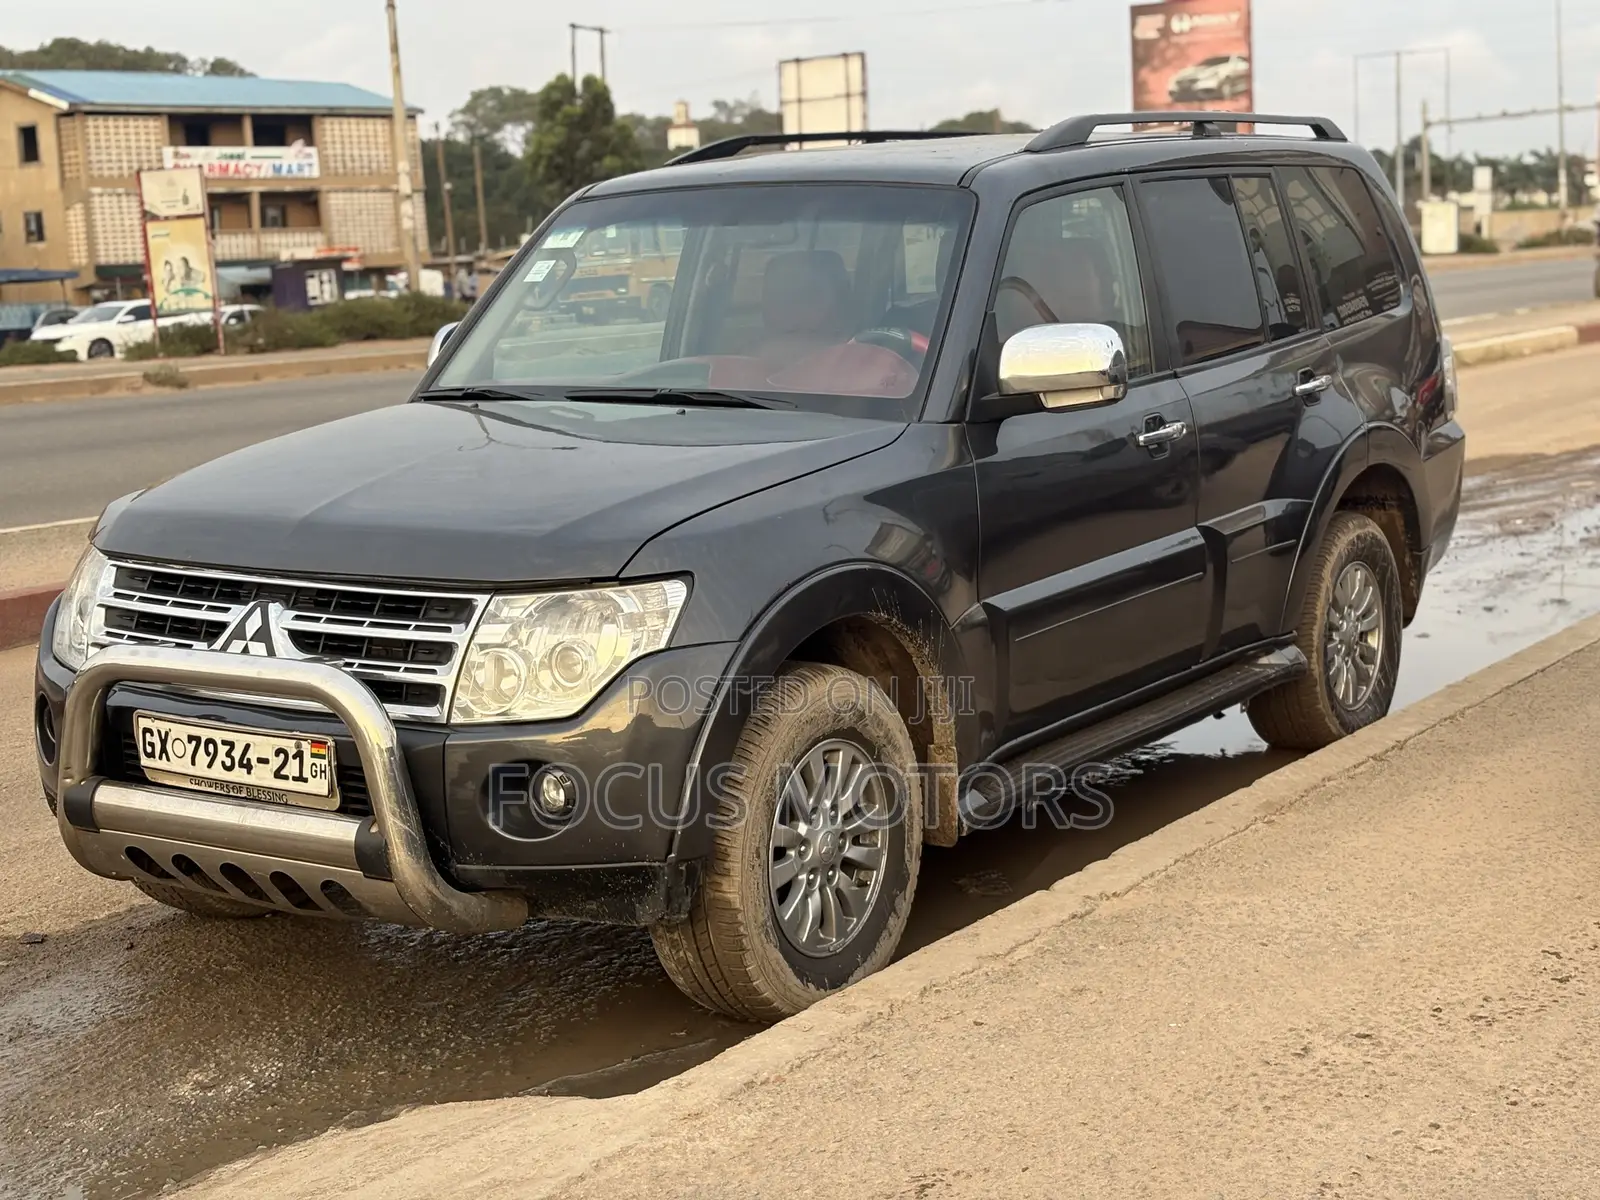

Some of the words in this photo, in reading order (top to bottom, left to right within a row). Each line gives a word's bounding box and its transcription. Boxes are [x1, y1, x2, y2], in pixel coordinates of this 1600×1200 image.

[271, 162, 314, 177] MART
[141, 726, 171, 762] GX
[187, 734, 309, 784] 7934-21
[310, 762, 327, 780] GH
[231, 785, 244, 795] OF
[245, 786, 288, 804] BLESSING
